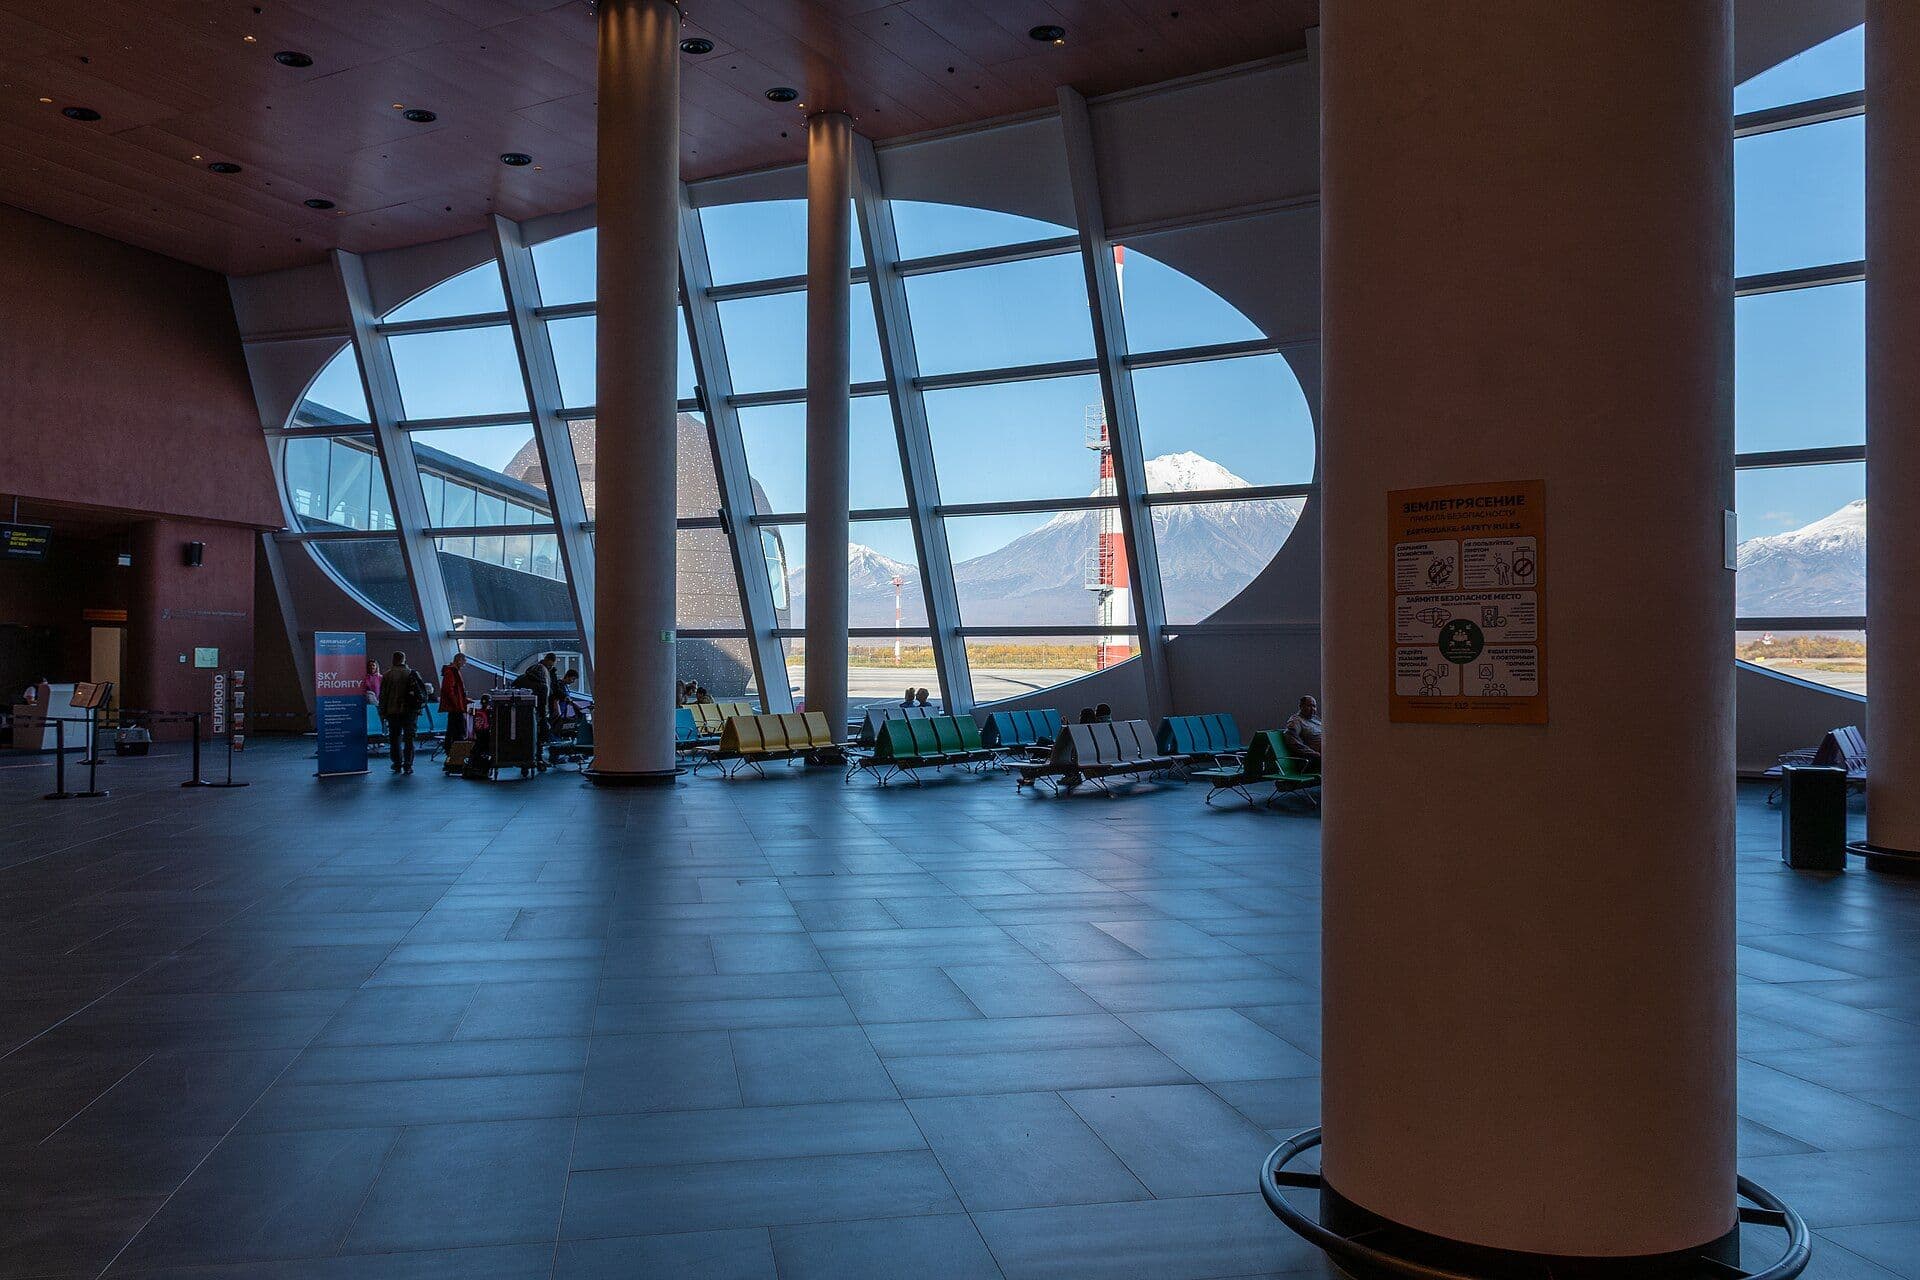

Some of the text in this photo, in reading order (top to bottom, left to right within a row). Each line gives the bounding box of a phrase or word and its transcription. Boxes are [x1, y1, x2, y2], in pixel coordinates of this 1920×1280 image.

[1402, 495, 1525, 513] ЗЕМЛЕТРЯСЕНИЕ
[1410, 510, 1516, 523] ПРАВИЛА БЕЗОПАСНОСТИ
[1461, 523, 1491, 532] SAFETY
[1492, 522, 1521, 531] RULES
[1406, 595, 1440, 604] ЗАЙМИТЕ
[1440, 593, 1493, 602] БЕЗОПАСНОЕ
[1494, 592, 1522, 601] МЕСТО
[317, 671, 338, 680] SKY
[317, 680, 363, 689] PRIORITY
